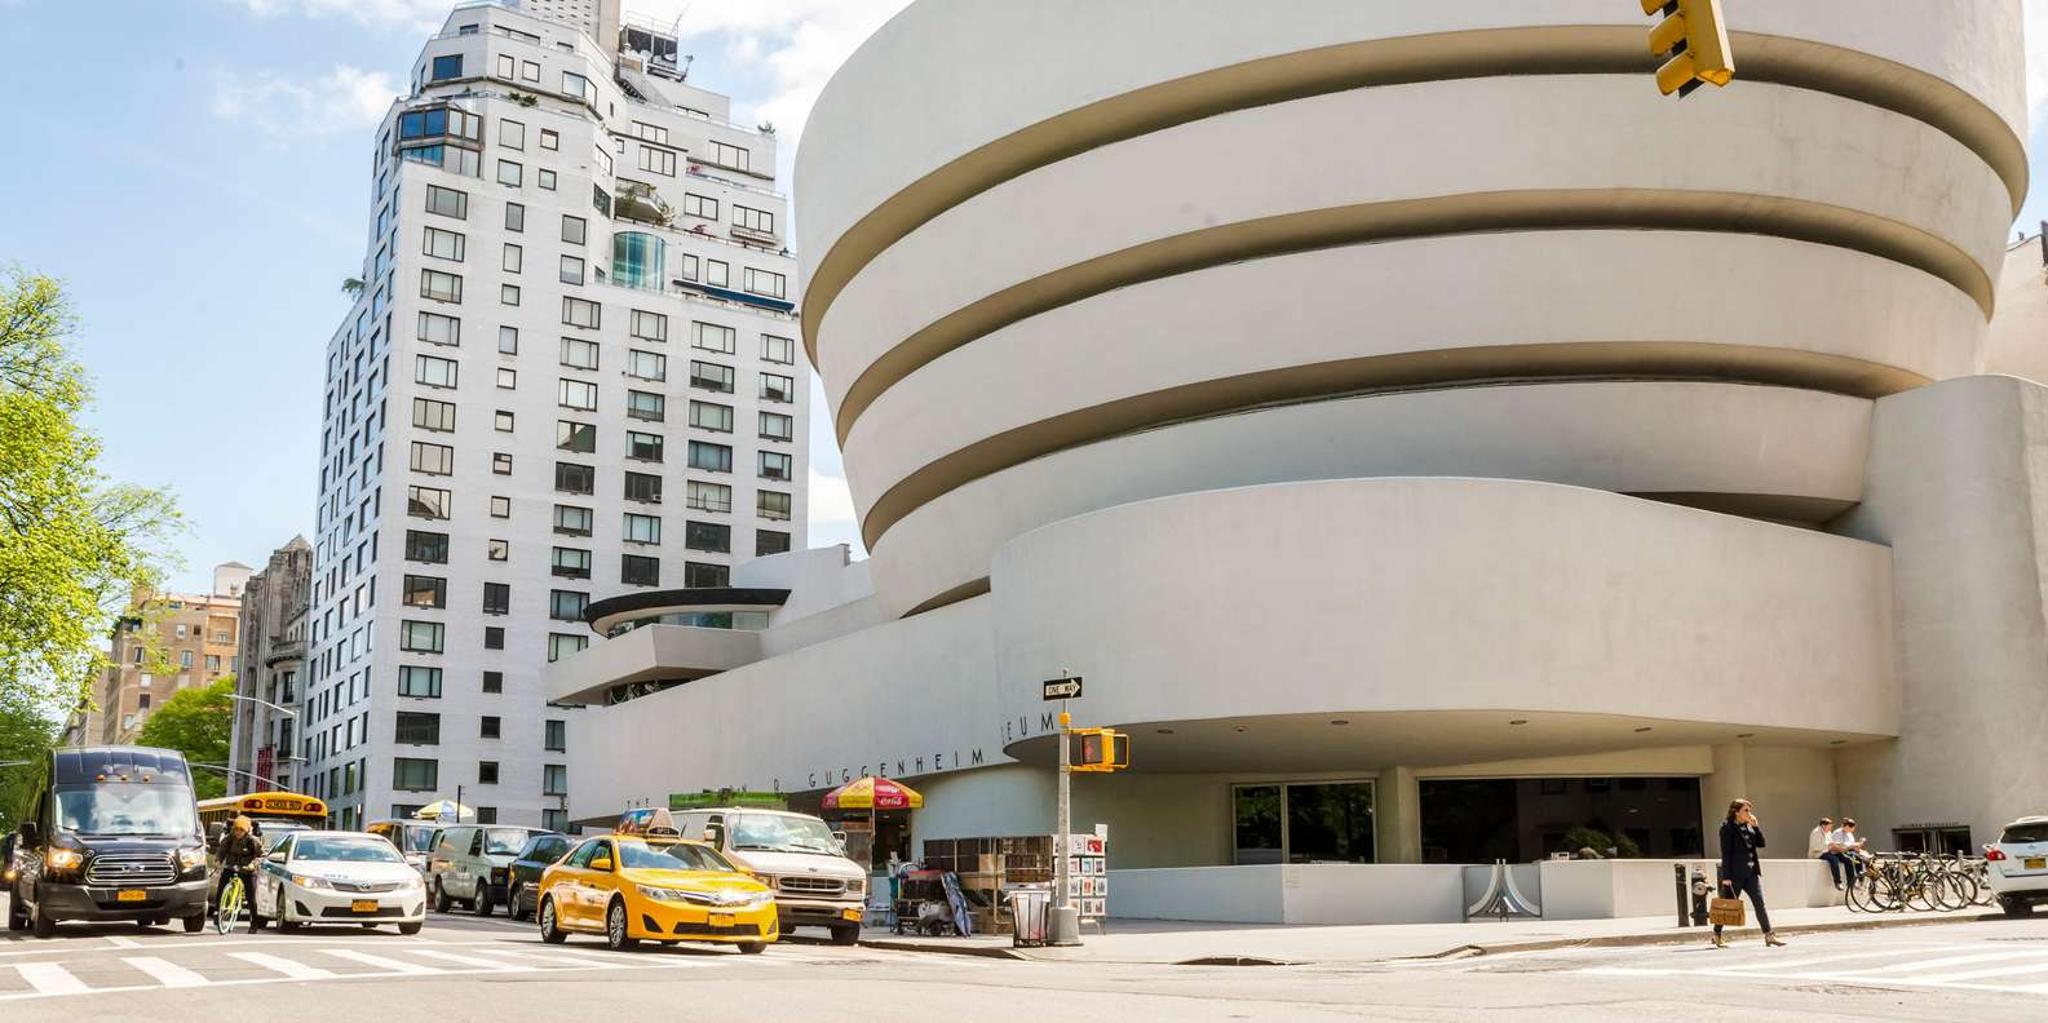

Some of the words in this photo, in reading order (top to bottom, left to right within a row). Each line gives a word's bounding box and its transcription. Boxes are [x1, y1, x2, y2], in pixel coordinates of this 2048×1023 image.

[1048, 685, 1060, 695] ONE
[1065, 684, 1076, 693] WAY
[808, 749, 984, 788] GUGGENHEIM
